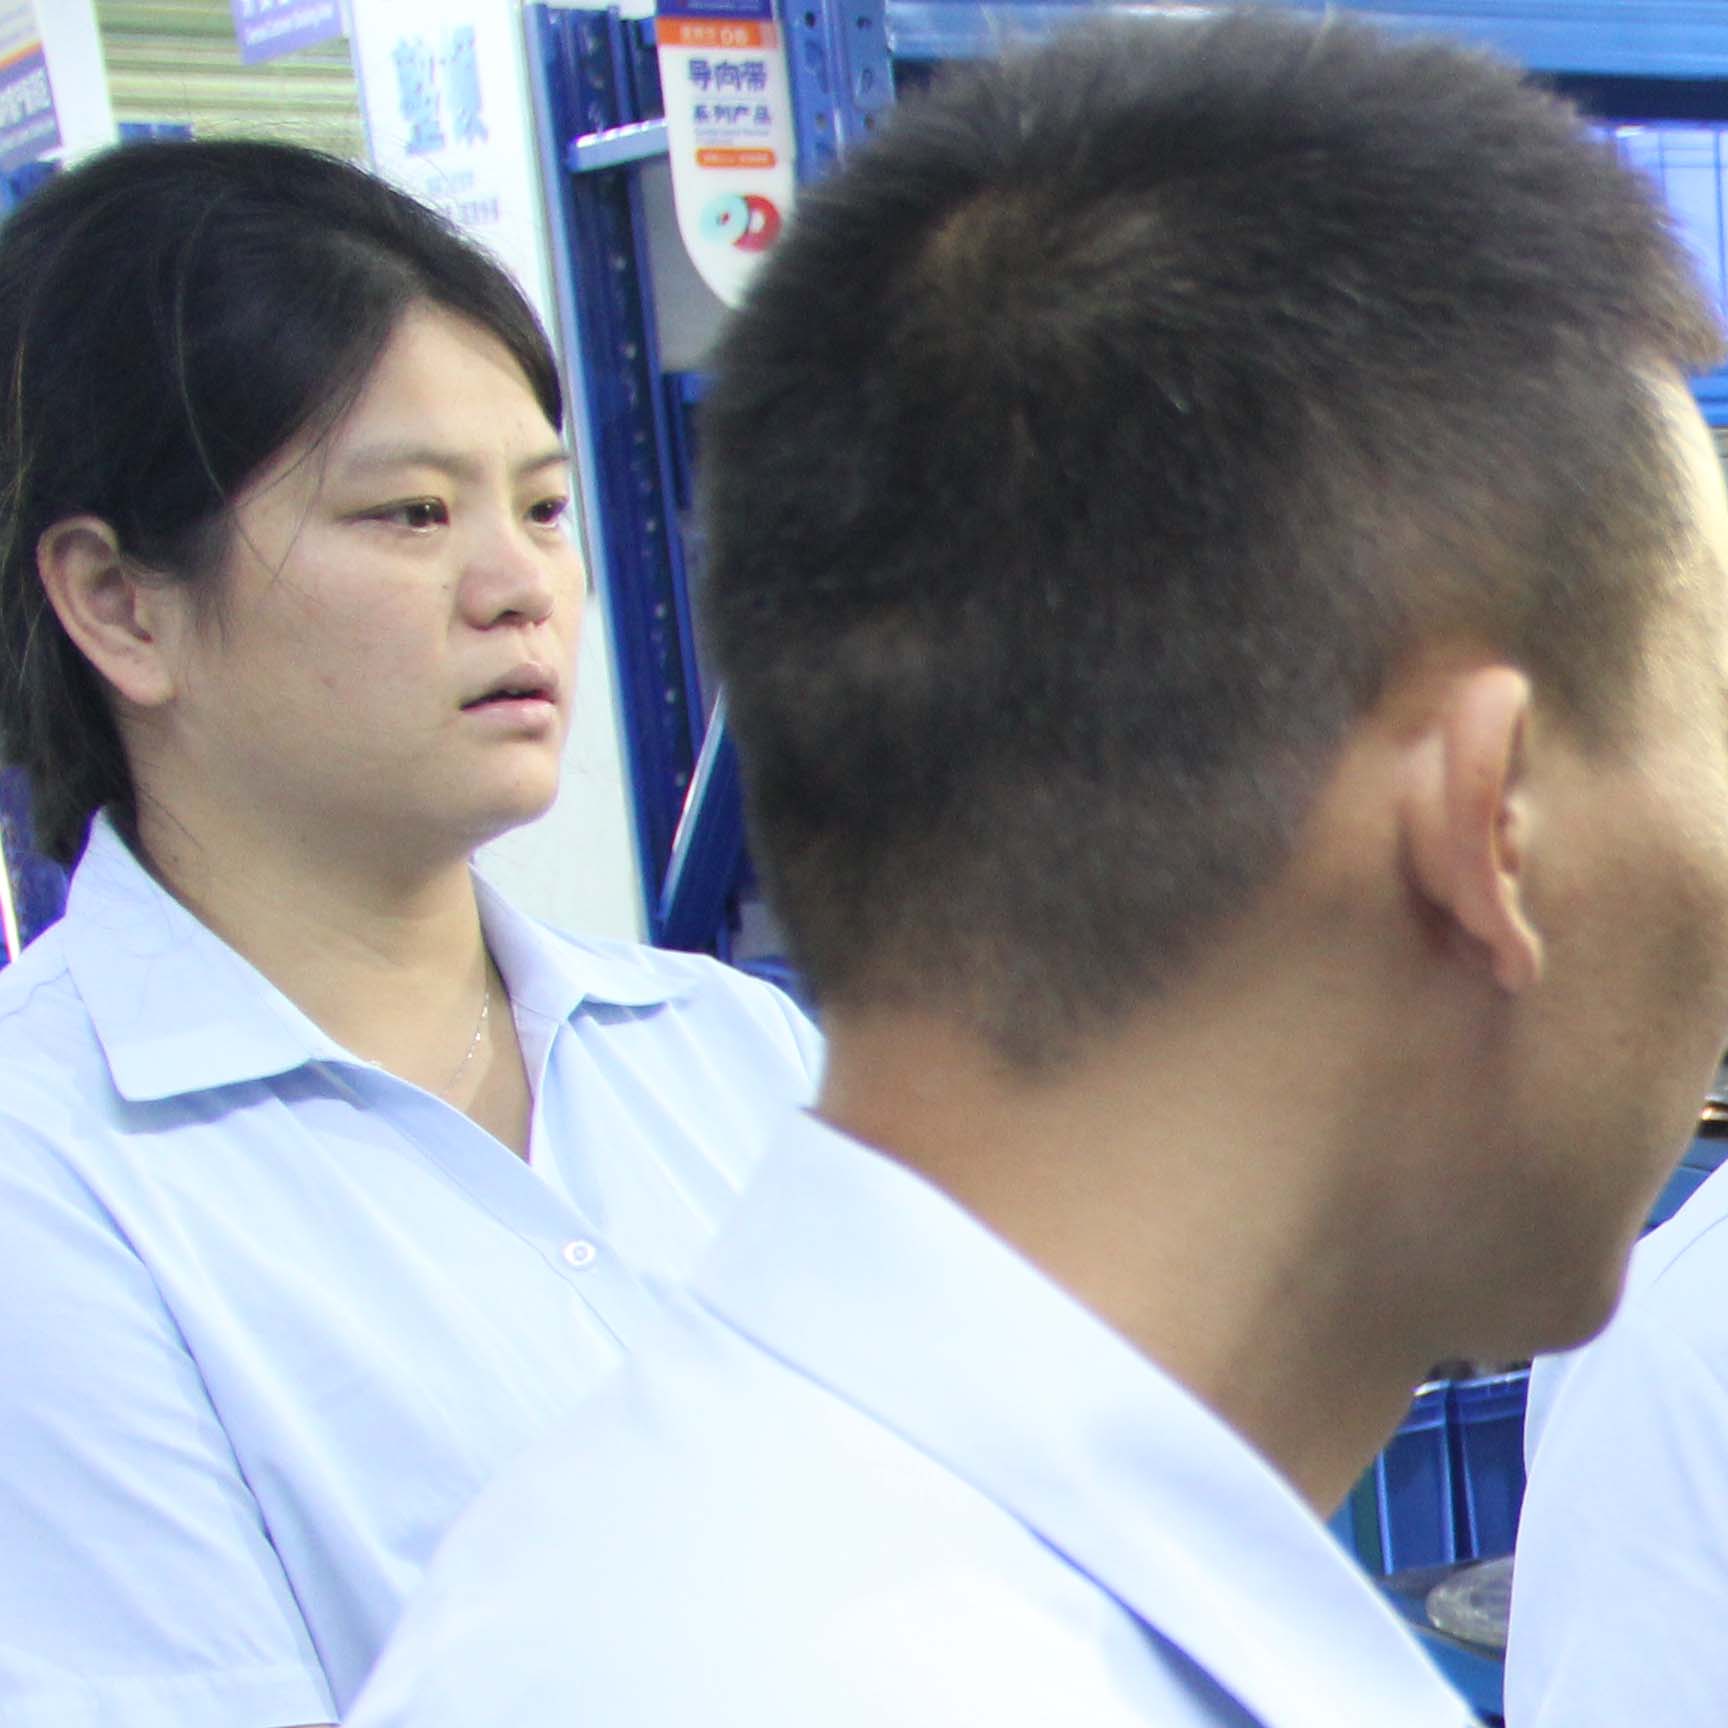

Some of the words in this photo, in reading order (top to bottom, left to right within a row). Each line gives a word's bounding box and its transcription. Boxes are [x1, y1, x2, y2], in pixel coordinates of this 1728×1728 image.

[688, 59, 767, 91] 导向带
[694, 105, 772, 125] 系列产品
